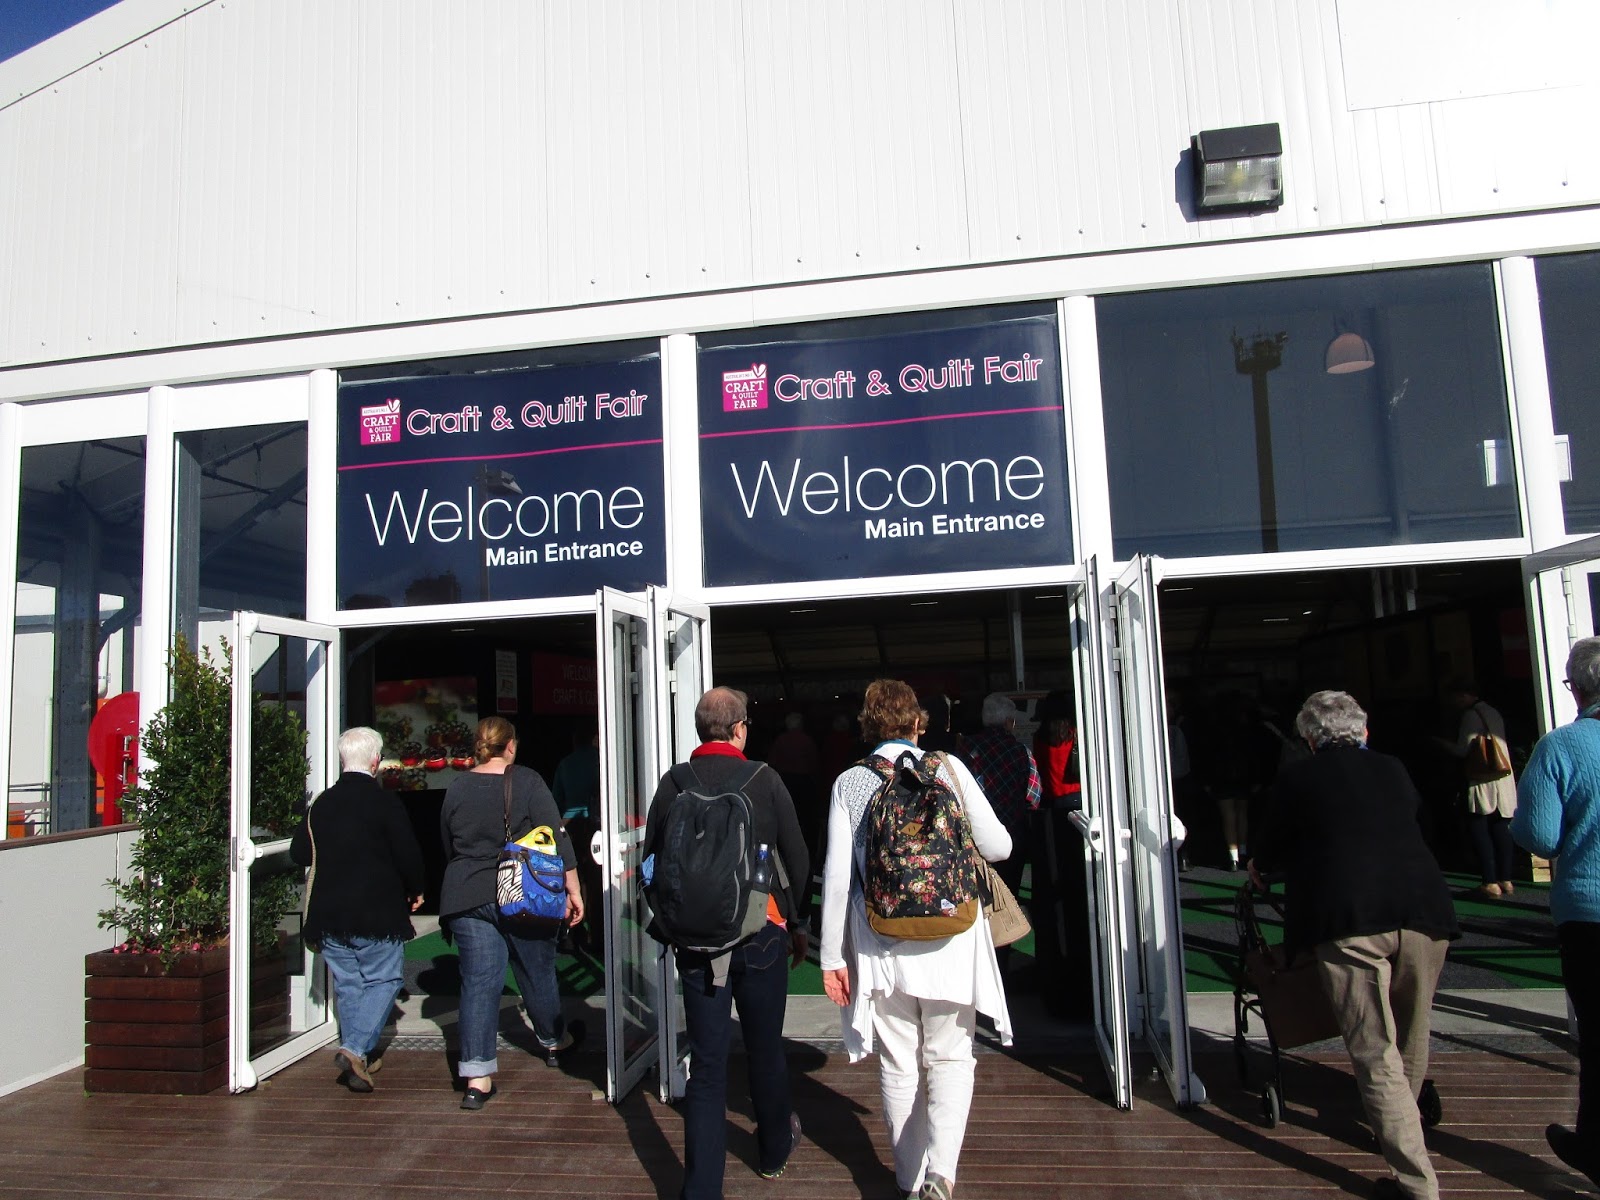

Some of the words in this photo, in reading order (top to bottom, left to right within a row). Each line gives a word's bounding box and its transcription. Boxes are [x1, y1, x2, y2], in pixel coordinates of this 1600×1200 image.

[726, 380, 764, 393] CRAFT
[774, 371, 856, 402] Craft
[866, 369, 892, 397] &
[899, 358, 975, 393] Quilt
[984, 353, 1044, 384] Fair
[734, 400, 757, 409] FAIR
[738, 392, 758, 400] QUILT
[364, 415, 398, 427] CRAFT
[406, 406, 482, 436] Craft
[490, 405, 515, 431] &
[521, 396, 588, 428] Quilt
[596, 389, 647, 420] Fair
[371, 433, 391, 442] FAIR
[731, 455, 1045, 519] Welcome
[365, 486, 644, 546] Welcome
[865, 516, 924, 540] Main
[932, 512, 1046, 536] Entrance
[485, 546, 538, 567] Main
[545, 540, 644, 563] Entrance
